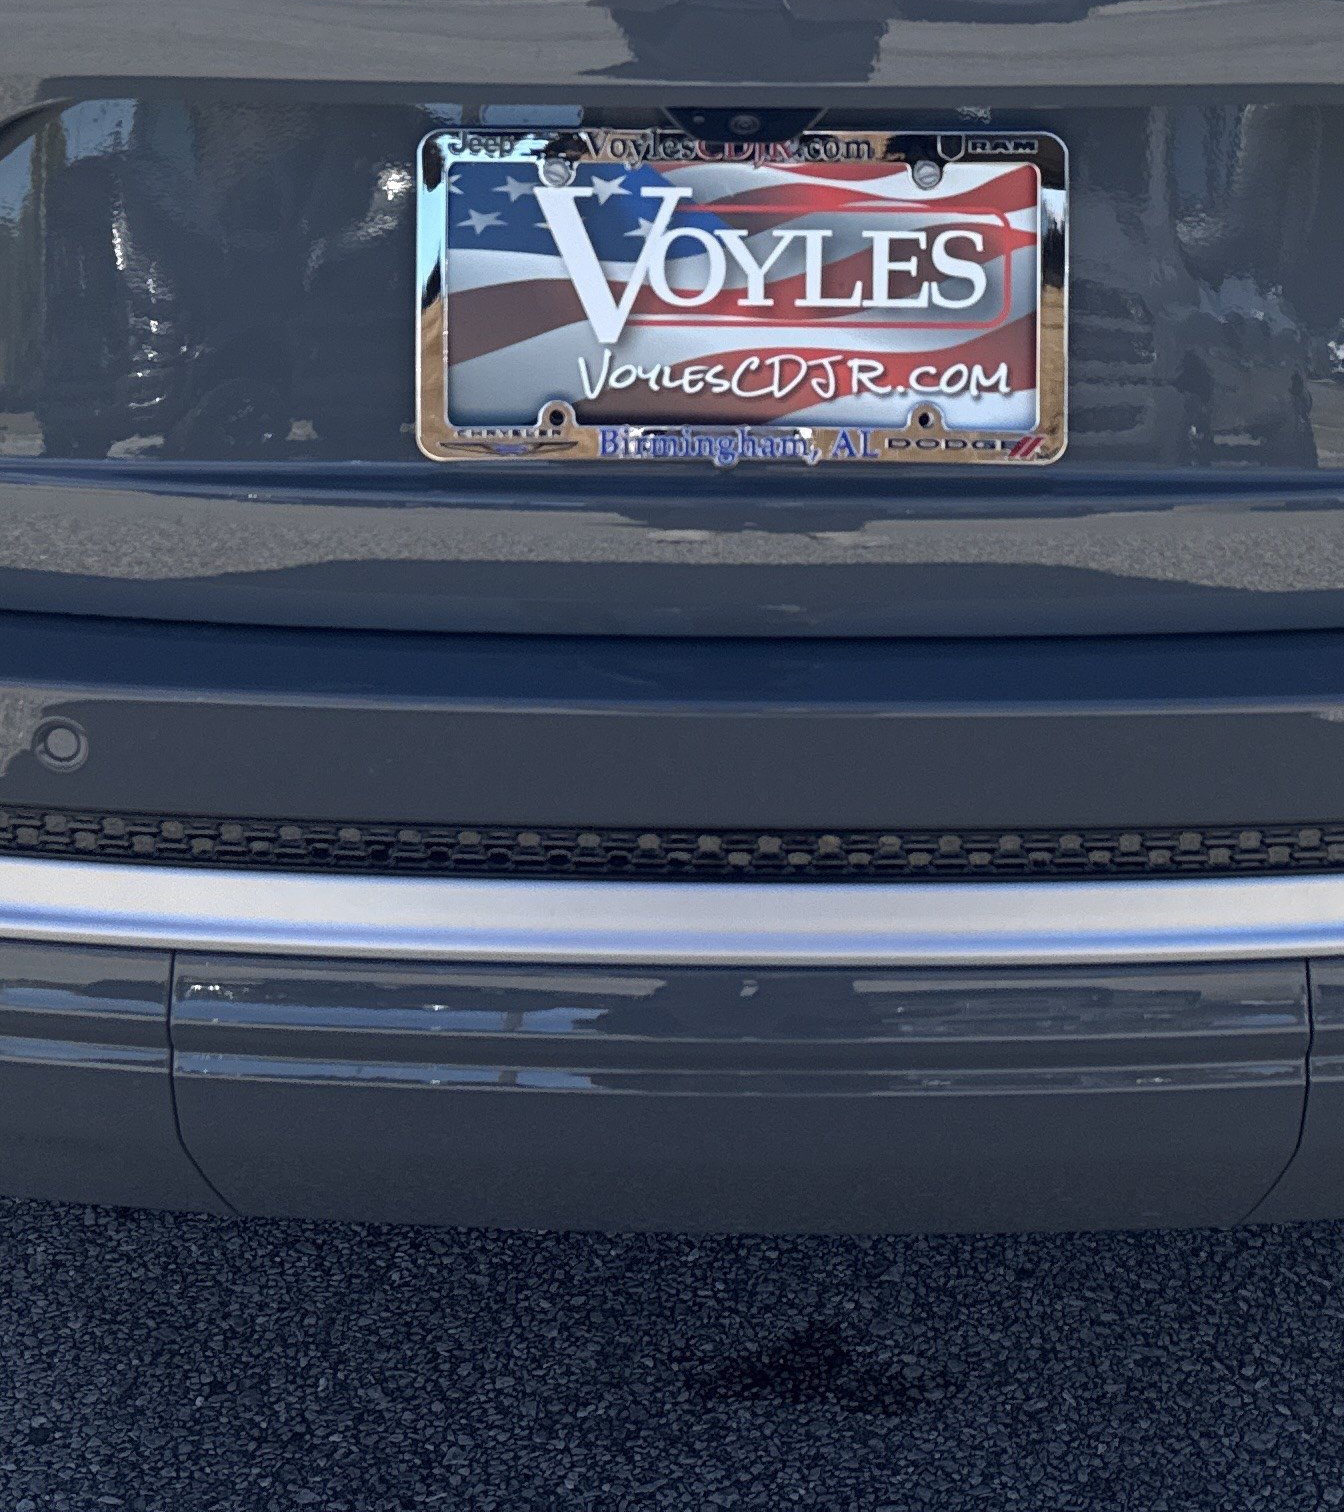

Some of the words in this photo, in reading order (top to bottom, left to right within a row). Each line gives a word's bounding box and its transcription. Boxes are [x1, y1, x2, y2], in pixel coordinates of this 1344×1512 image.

[447, 132, 516, 158] Jeep
[968, 139, 1038, 154] RAM
[533, 186, 988, 344] VOYLES
[831, 428, 880, 459] AL
[884, 438, 1017, 451] DODGE
